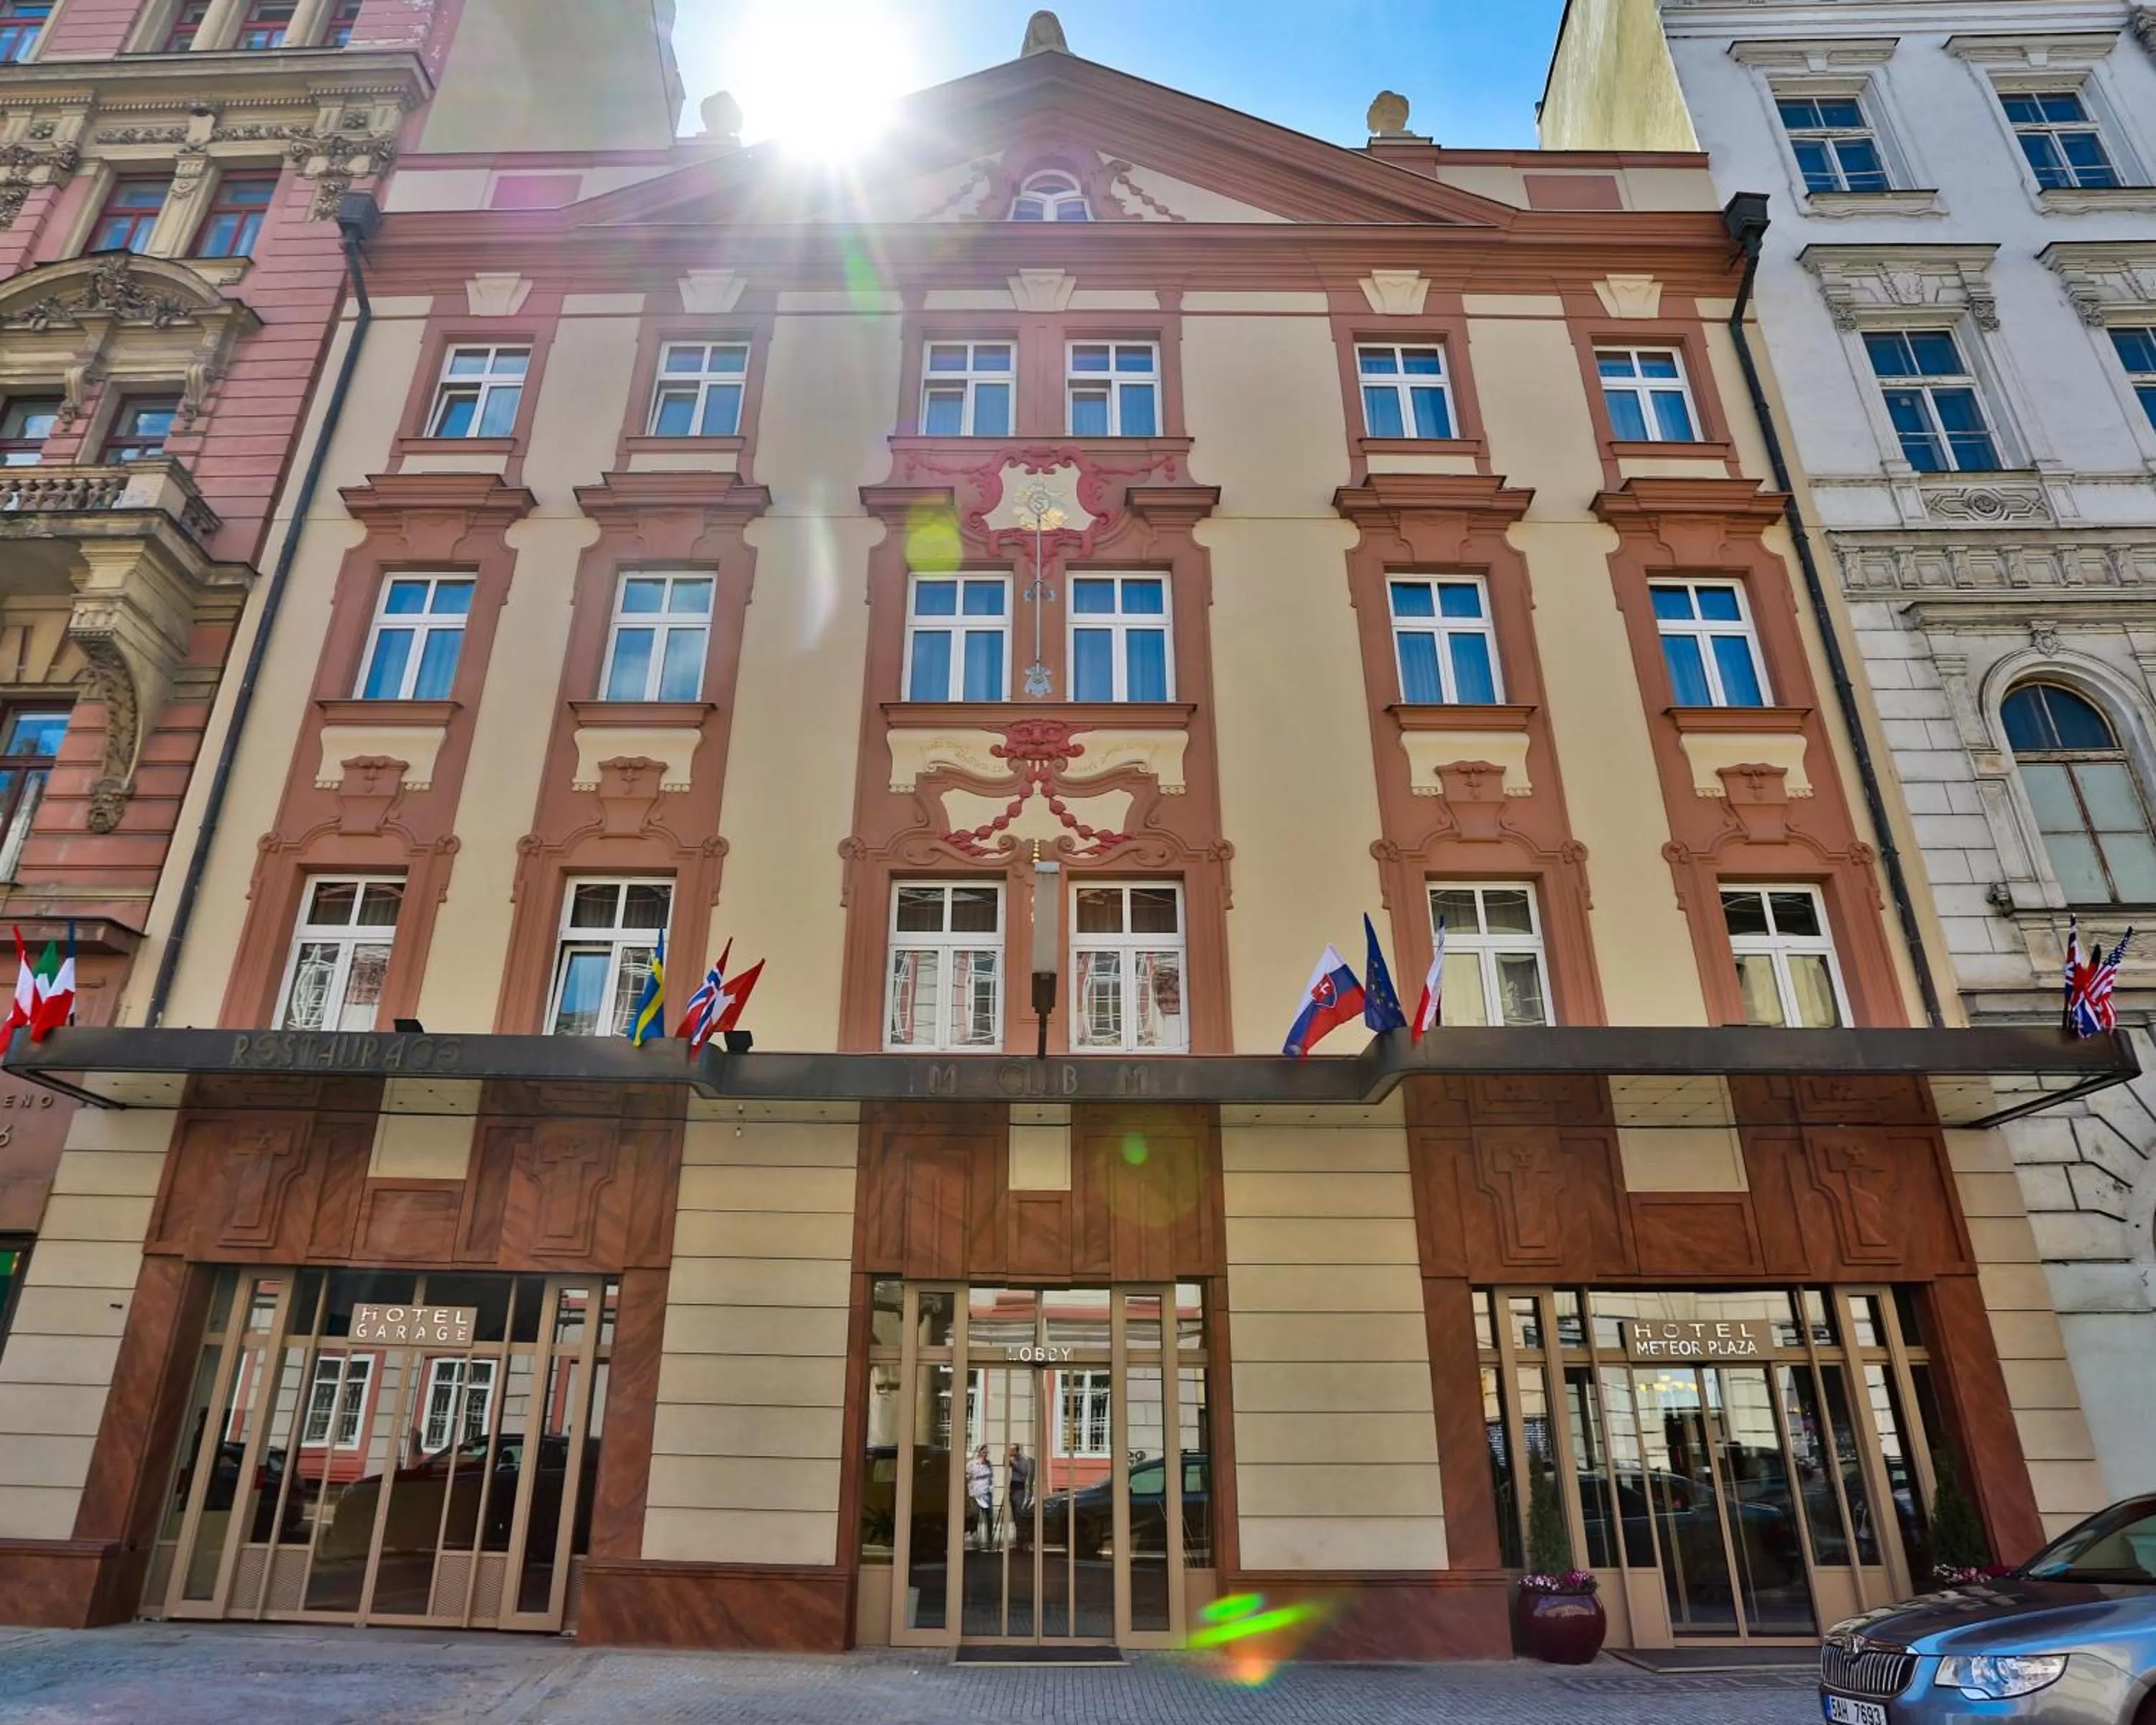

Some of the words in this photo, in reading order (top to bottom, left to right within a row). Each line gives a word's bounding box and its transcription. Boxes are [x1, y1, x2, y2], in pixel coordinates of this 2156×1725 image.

[361, 1307, 468, 1325] HOTEL
[356, 1323, 467, 1340] GARAGE
[1634, 1323, 1756, 1338] HOTEL
[1008, 1346, 1071, 1361] LOBBY
[1635, 1340, 1703, 1356] METEOR
[1708, 1340, 1758, 1355] PLAZA
